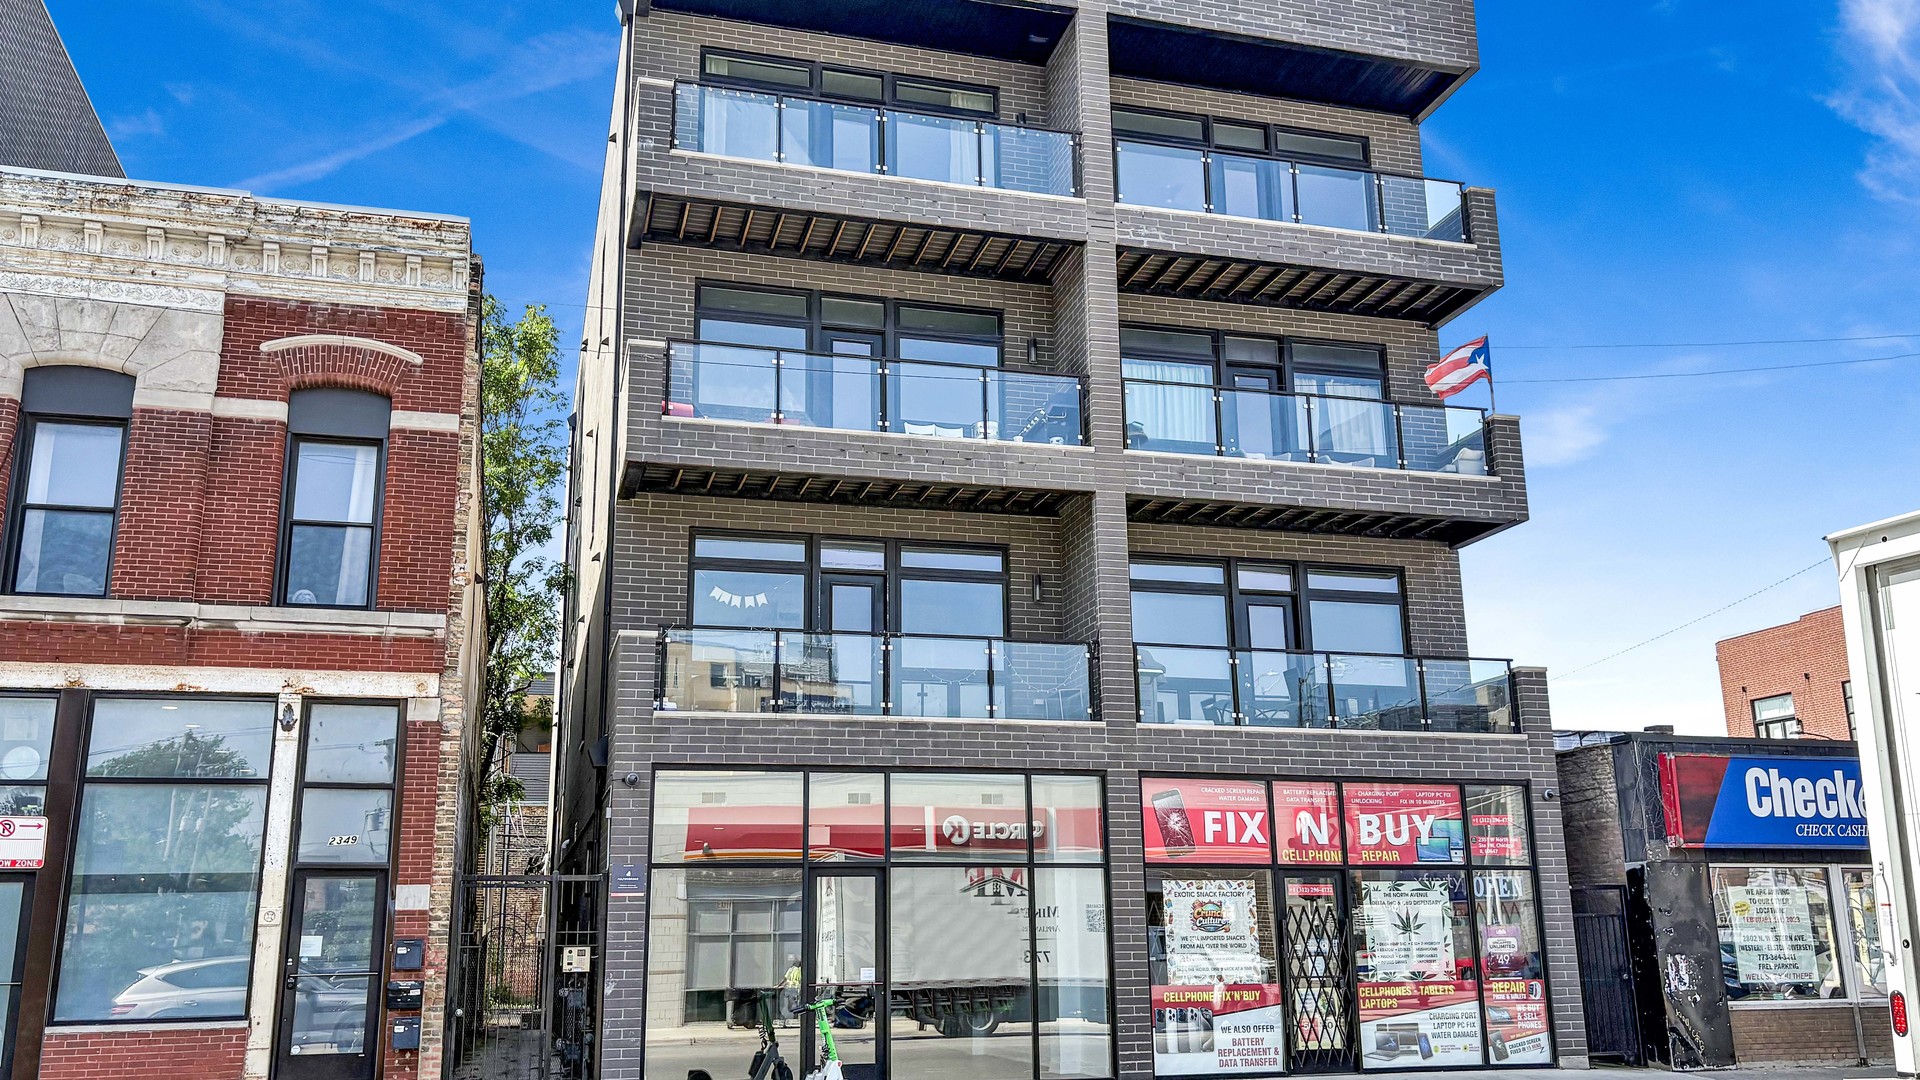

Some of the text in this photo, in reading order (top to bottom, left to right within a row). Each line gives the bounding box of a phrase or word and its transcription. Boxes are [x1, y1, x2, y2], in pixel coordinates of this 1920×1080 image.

[1306, 789, 1347, 797] REPLACEMET
[1204, 811, 1435, 846] FIX N BUY
[1795, 824, 1836, 837] CHECK
[328, 835, 358, 846] 2349
[1362, 850, 1400, 862] REPAIR
[1194, 908, 1226, 919] Crunc
[1359, 986, 1412, 997] CELLPHONES
[1419, 984, 1456, 995] TABLETS
[1492, 981, 1526, 993] REPAIR
[1163, 991, 1215, 1003] CELLPHONE
[1360, 998, 1398, 1009] LAPTOPS
[1517, 1012, 1539, 1020] & SELL
[1220, 1024, 1275, 1034] WE ALSO OFFER
[1517, 1020, 1542, 1029] PHONES
[1431, 1030, 1478, 1039] WATER DAMAGE
[1231, 1037, 1265, 1047] BATTERY
[1508, 1037, 1542, 1049] CRACKED SCREEN
[1217, 1046, 1280, 1057] REPLACEMENT &
[1218, 1057, 1278, 1068] DATA TRANSFER
